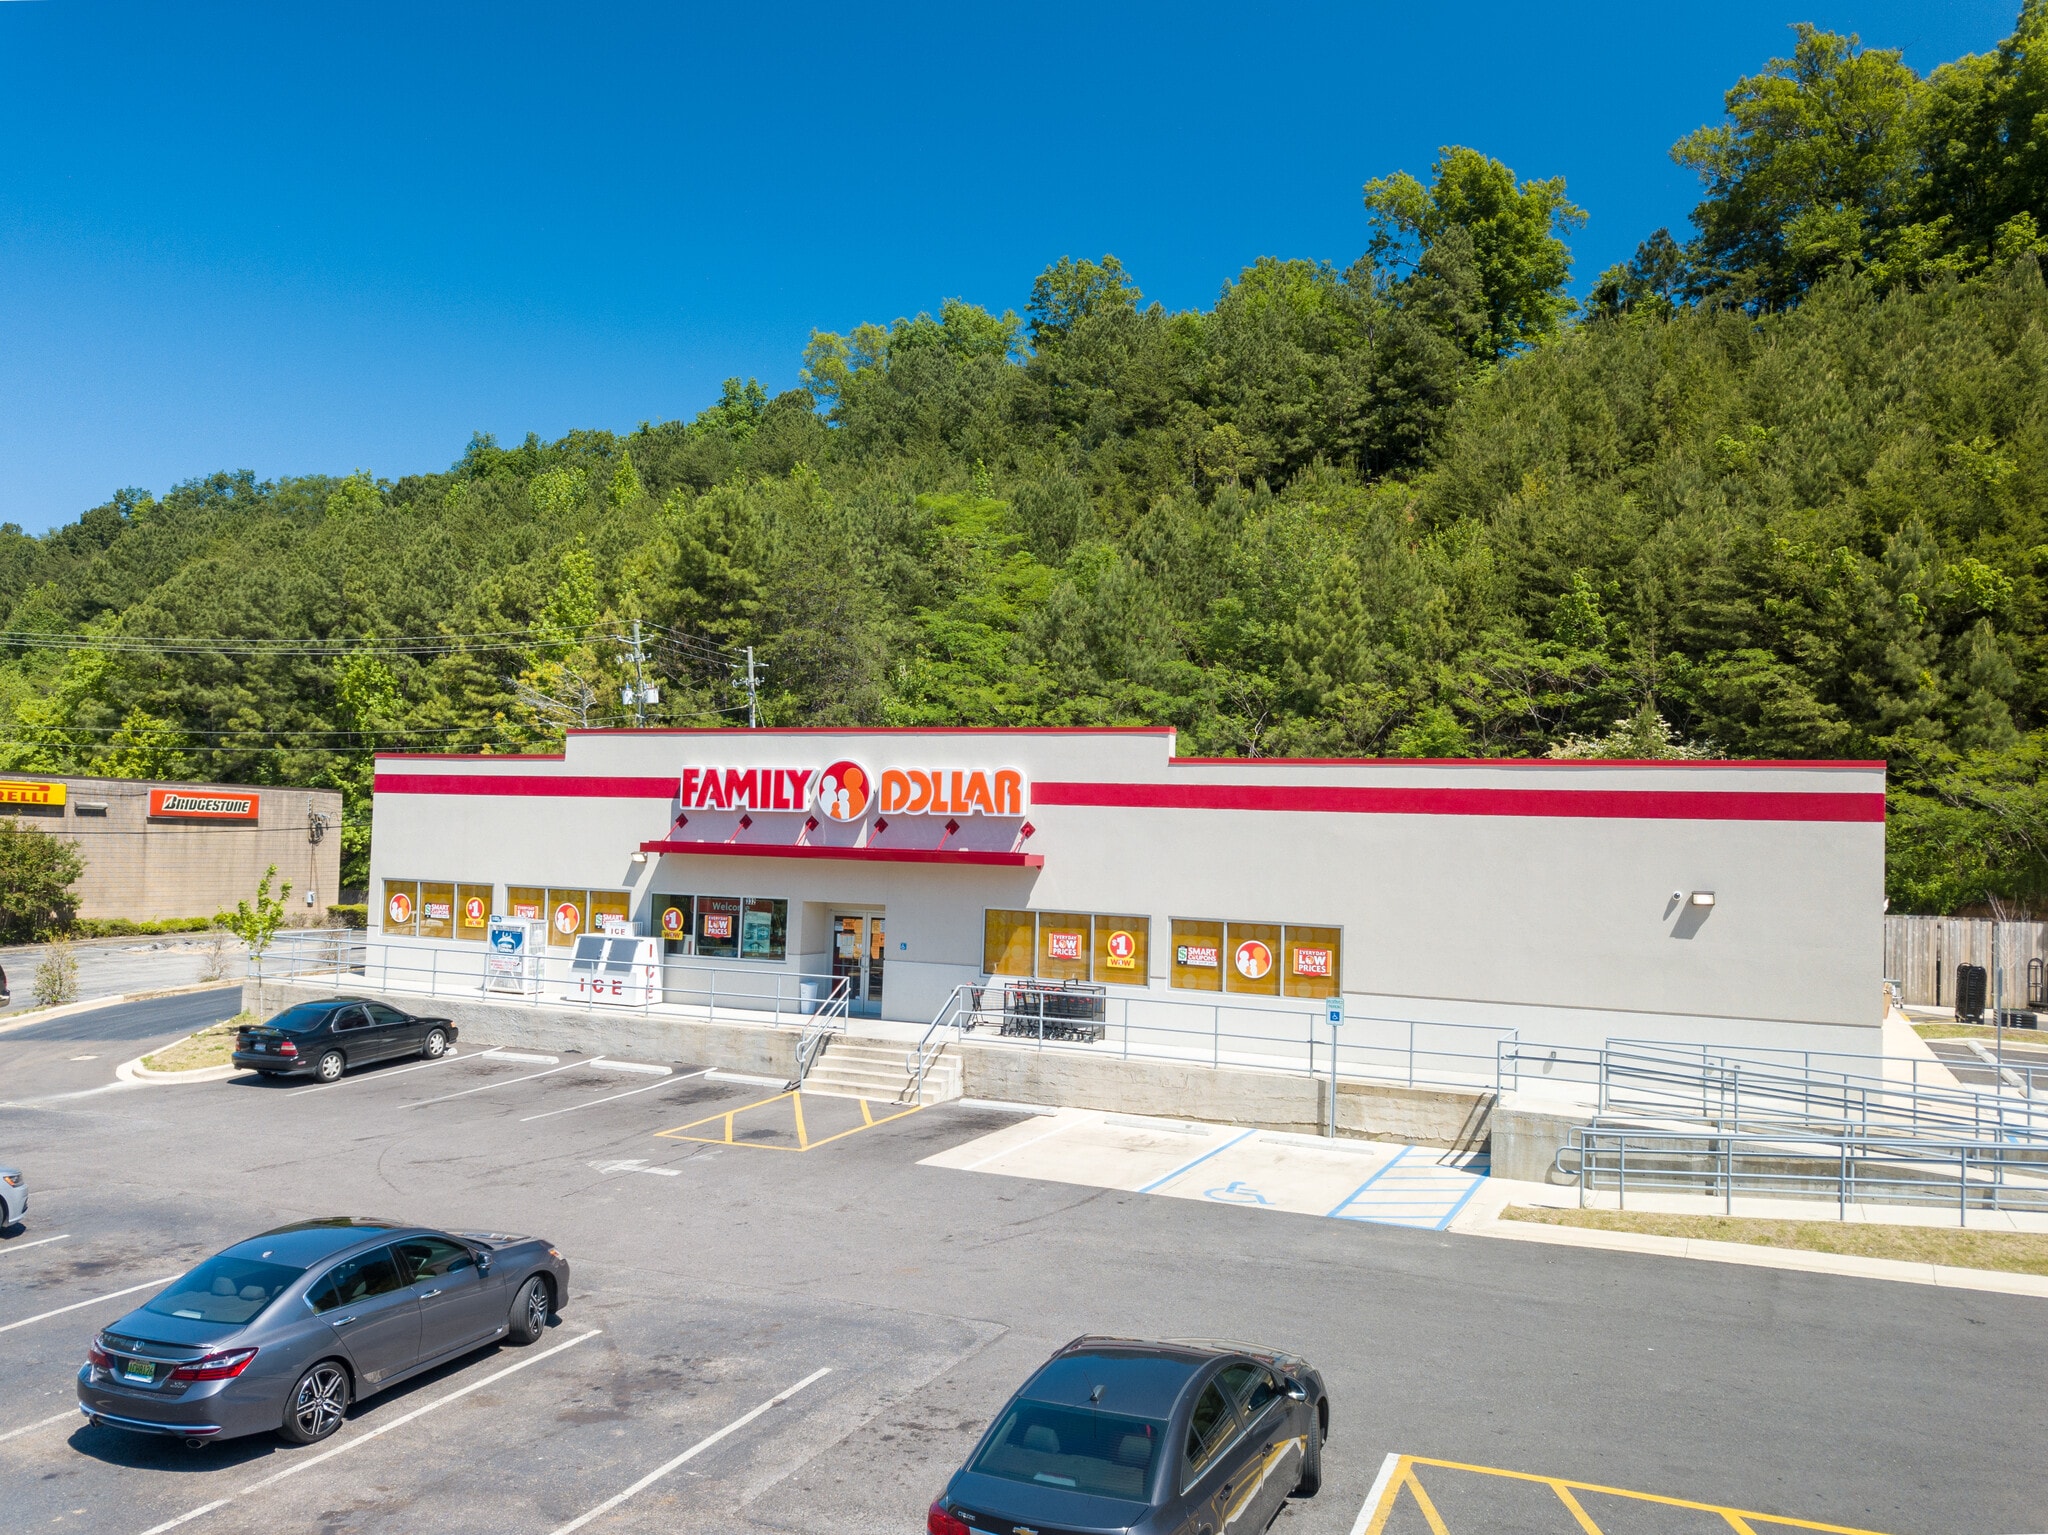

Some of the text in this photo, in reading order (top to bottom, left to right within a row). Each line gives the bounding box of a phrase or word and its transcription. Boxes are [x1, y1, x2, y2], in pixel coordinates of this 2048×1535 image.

[682, 768, 1022, 813] FAMILY DOLLAR
[163, 795, 250, 812] BRIDGESTONE
[665, 911, 678, 929] $1
[610, 928, 625, 936] ICE
[1053, 939, 1077, 949] LOW
[1112, 935, 1128, 955] $1
[1053, 947, 1077, 956] PRICES
[1188, 947, 1217, 956] SMART
[1188, 954, 1217, 962] COUPONS
[1299, 954, 1326, 966] LOW
[1298, 964, 1326, 973] PRICES
[580, 977, 623, 996] ICE
